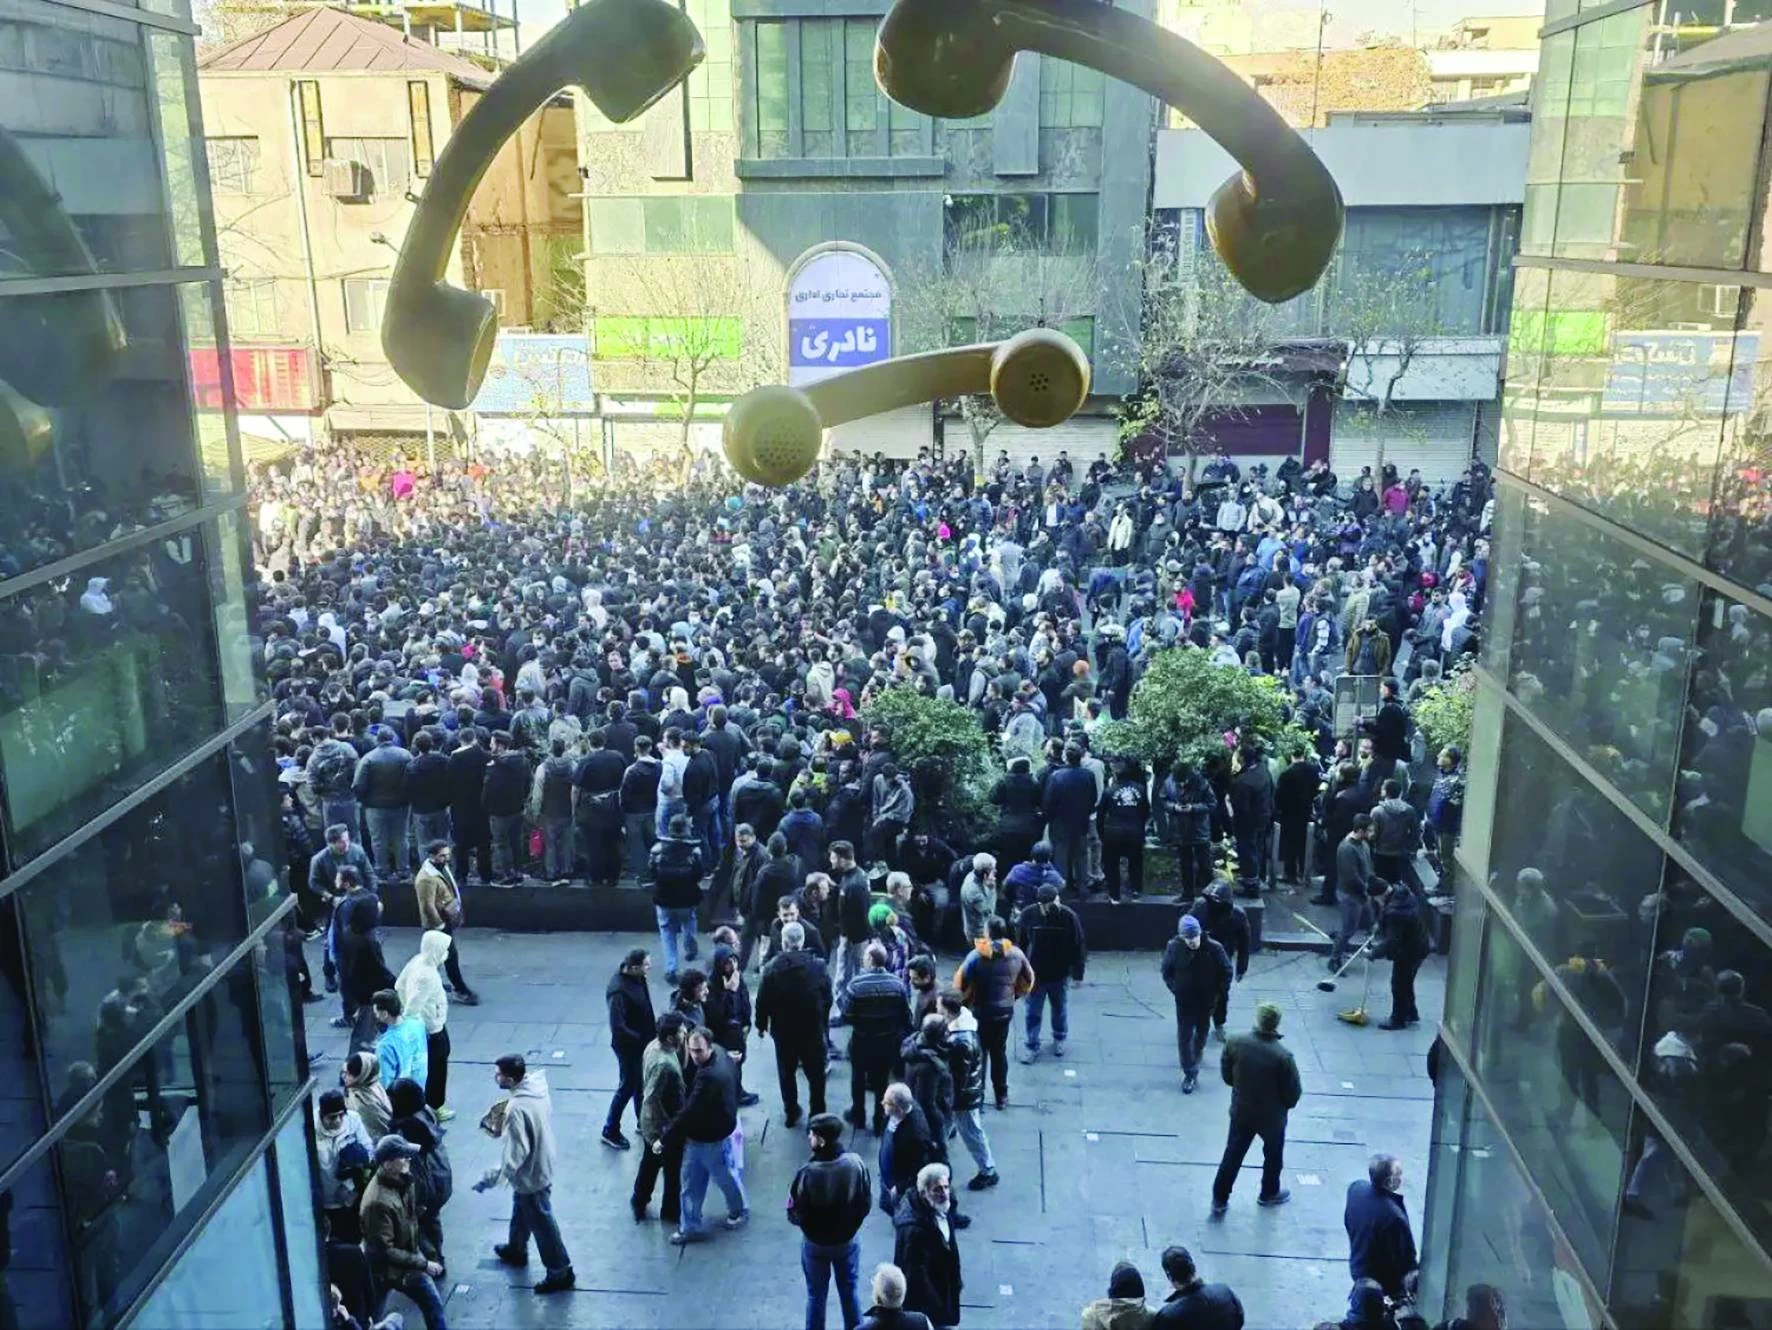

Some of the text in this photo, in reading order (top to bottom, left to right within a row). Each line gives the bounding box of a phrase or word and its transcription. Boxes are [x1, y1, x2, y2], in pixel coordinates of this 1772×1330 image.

[795, 288, 882, 302] مجتمع تجاری اداری
[801, 325, 877, 362] نادری
